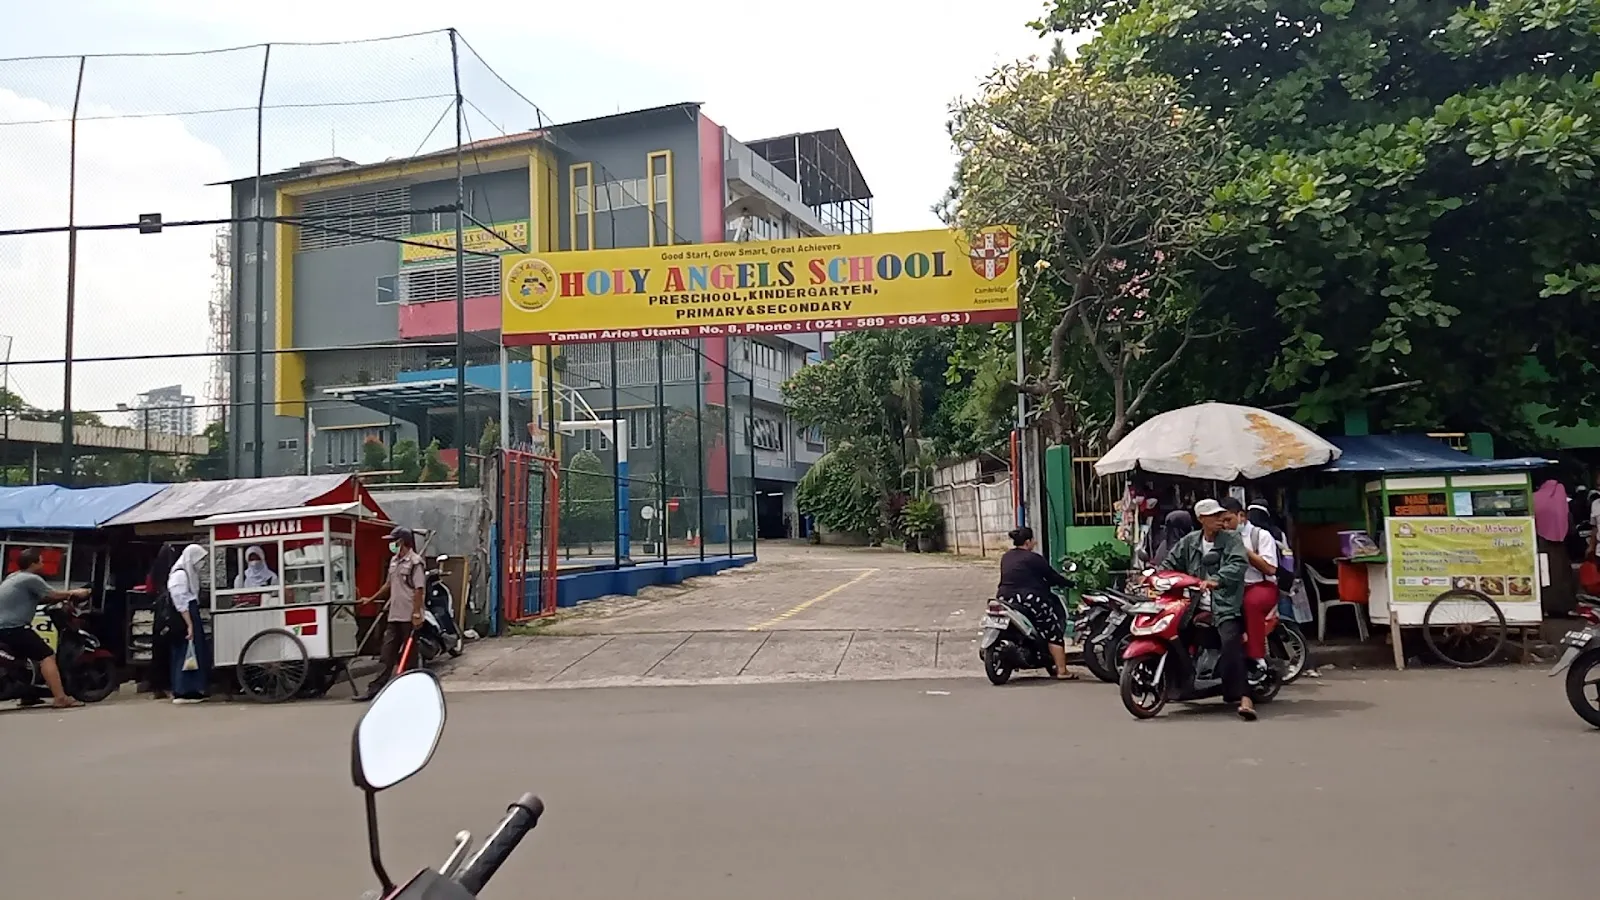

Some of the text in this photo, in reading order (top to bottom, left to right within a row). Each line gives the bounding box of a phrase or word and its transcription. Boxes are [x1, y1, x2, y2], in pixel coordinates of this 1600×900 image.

[661, 242, 842, 260] Good Start, Grow Smart, Great Achievers
[559, 250, 953, 297] HOLY ANGELS SCHOOL
[974, 286, 1008, 294] Cambridge
[549, 332, 597, 341] Taman
[601, 329, 639, 339] Aries
[642, 326, 690, 337] Utama
[699, 325, 724, 334] No.
[727, 325, 742, 334] 8,
[746, 322, 792, 332] Phone
[815, 319, 842, 329] 021
[857, 317, 885, 327] 589
[898, 315, 927, 325] 084
[940, 313, 961, 323] 93
[238, 520, 302, 537] TAKOYAKI
